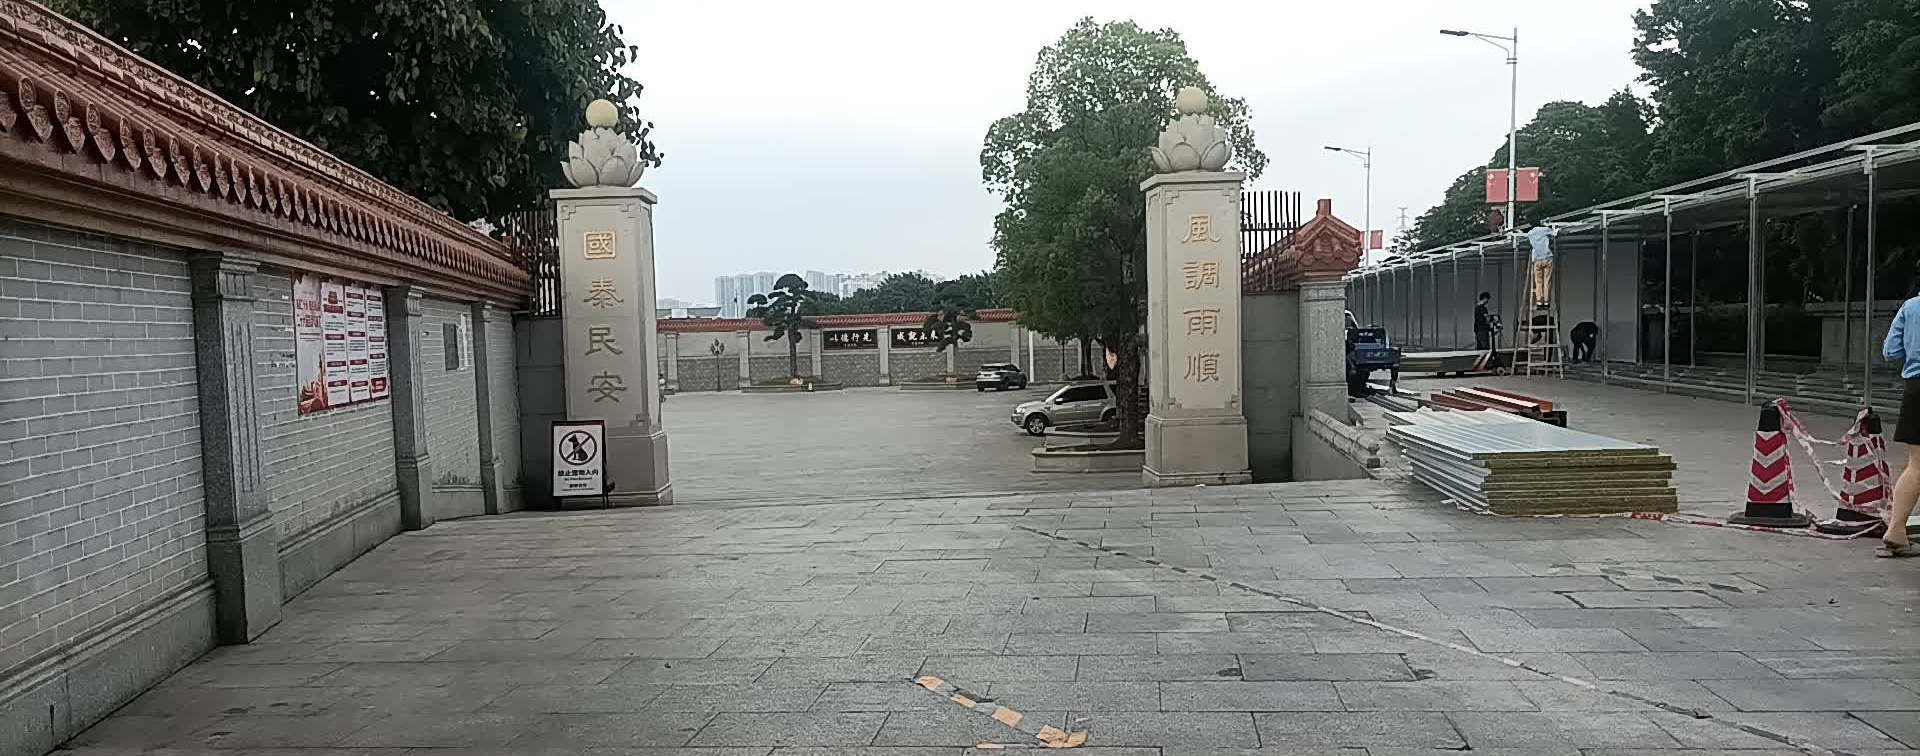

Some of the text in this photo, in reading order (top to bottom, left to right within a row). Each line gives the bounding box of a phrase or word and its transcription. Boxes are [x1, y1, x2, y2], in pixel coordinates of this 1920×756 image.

[583, 230, 629, 403] 國泰民安
[1181, 212, 1222, 383] 風調雨順
